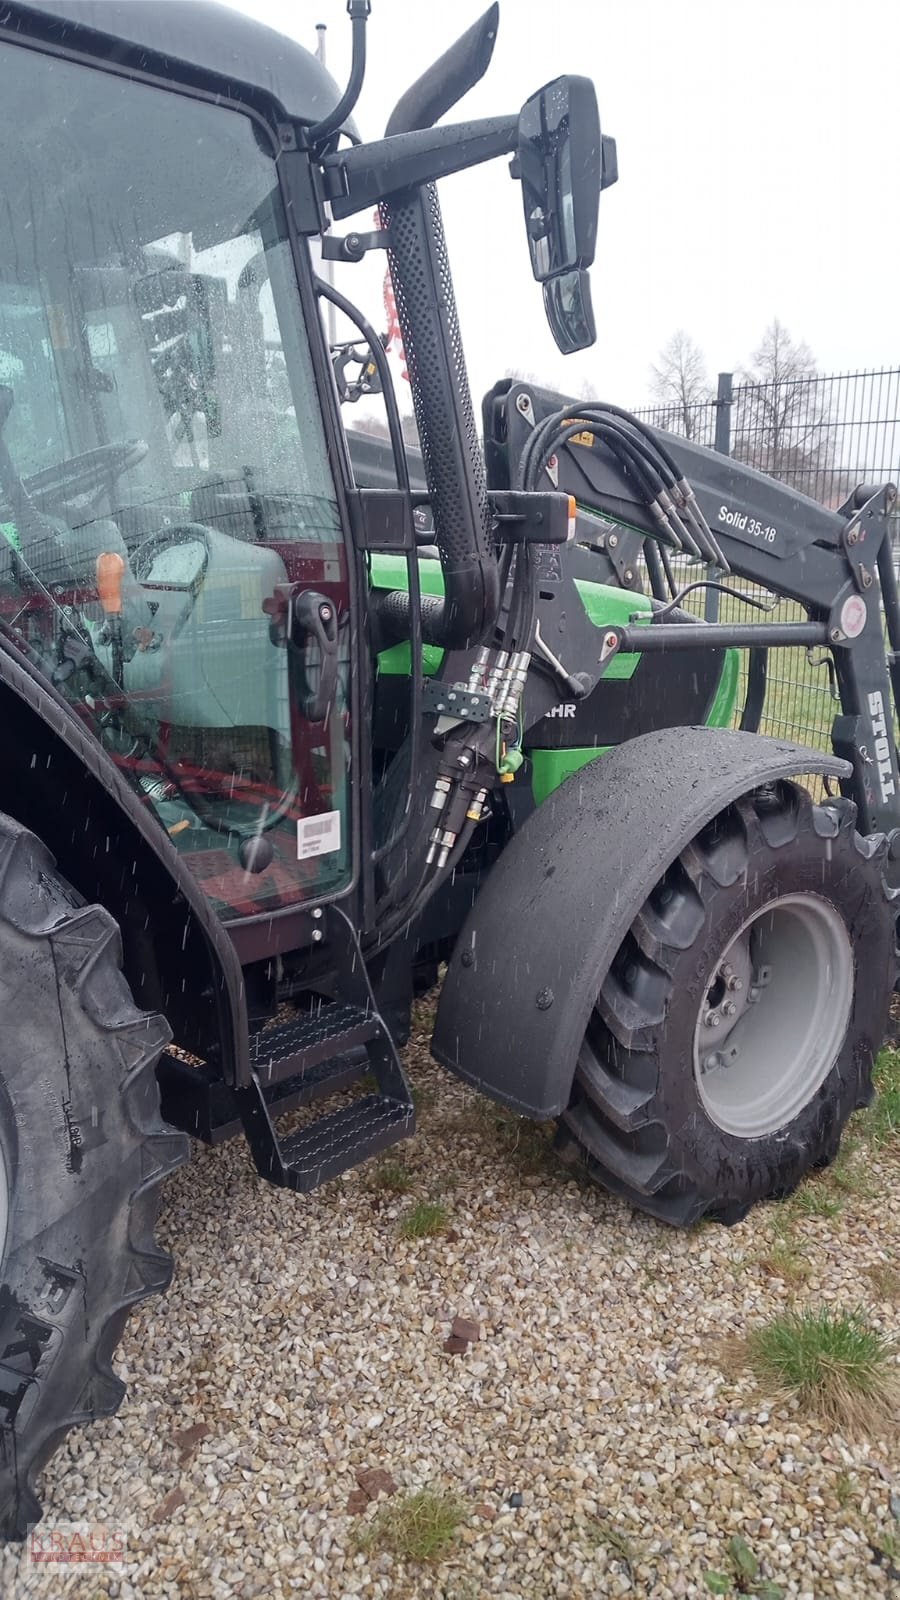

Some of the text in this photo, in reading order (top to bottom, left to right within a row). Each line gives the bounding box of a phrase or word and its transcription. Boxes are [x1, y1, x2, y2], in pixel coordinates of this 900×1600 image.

[718, 505, 776, 543] Solid 35-18
[867, 690, 896, 804] STOLL
